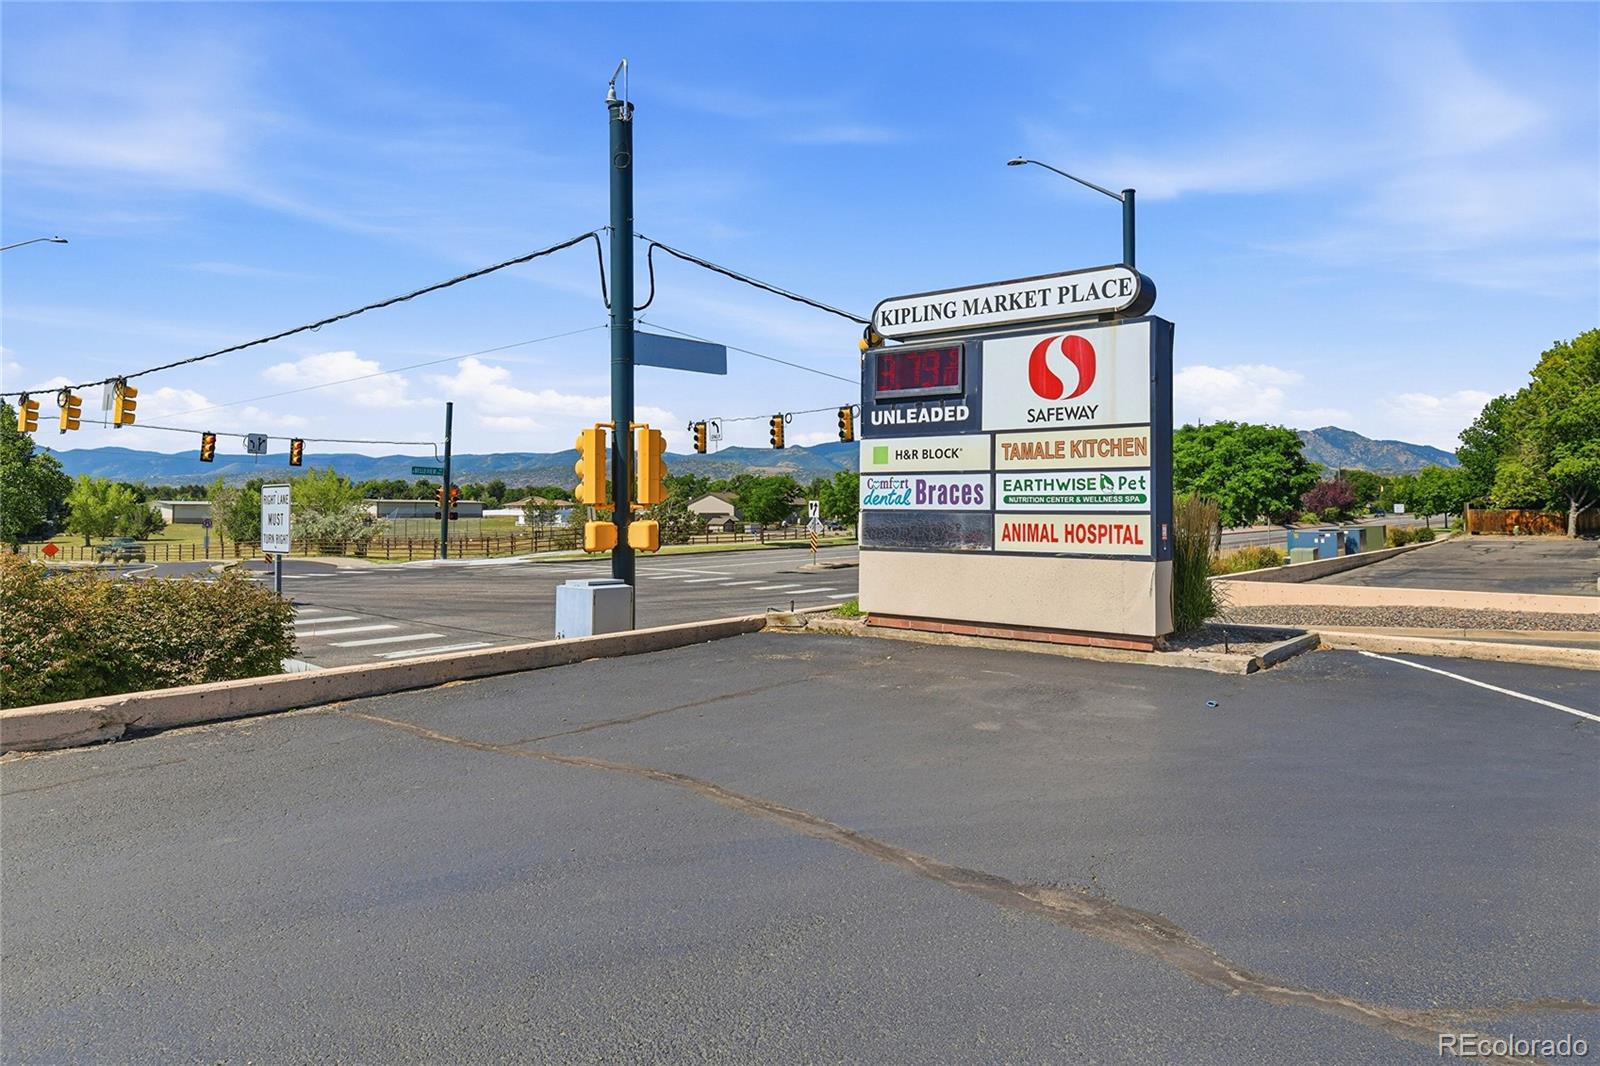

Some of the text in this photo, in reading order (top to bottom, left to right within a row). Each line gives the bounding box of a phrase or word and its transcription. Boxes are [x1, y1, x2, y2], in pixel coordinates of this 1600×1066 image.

[880, 277, 1134, 327] KIPLING MARKET PLACE
[871, 405, 970, 426] UNLEADED
[1027, 404, 1099, 423] SAFEWAY
[895, 448, 959, 460] H&R BLOCK
[1001, 436, 1148, 461] TAMALE KITCHEN
[915, 479, 984, 505] Braces
[1003, 475, 1146, 492] EARTHWISE Pet
[263, 494, 289, 505] RIGHT LANE
[863, 488, 912, 506] dental
[1082, 495, 1123, 503] WELLNESS
[1124, 495, 1140, 503] SPA
[268, 513, 283, 525] MUST
[263, 534, 289, 544] TURN RIGHT
[1001, 523, 1059, 543] ANIMAL
[1064, 523, 1144, 545] HOSPITAL
